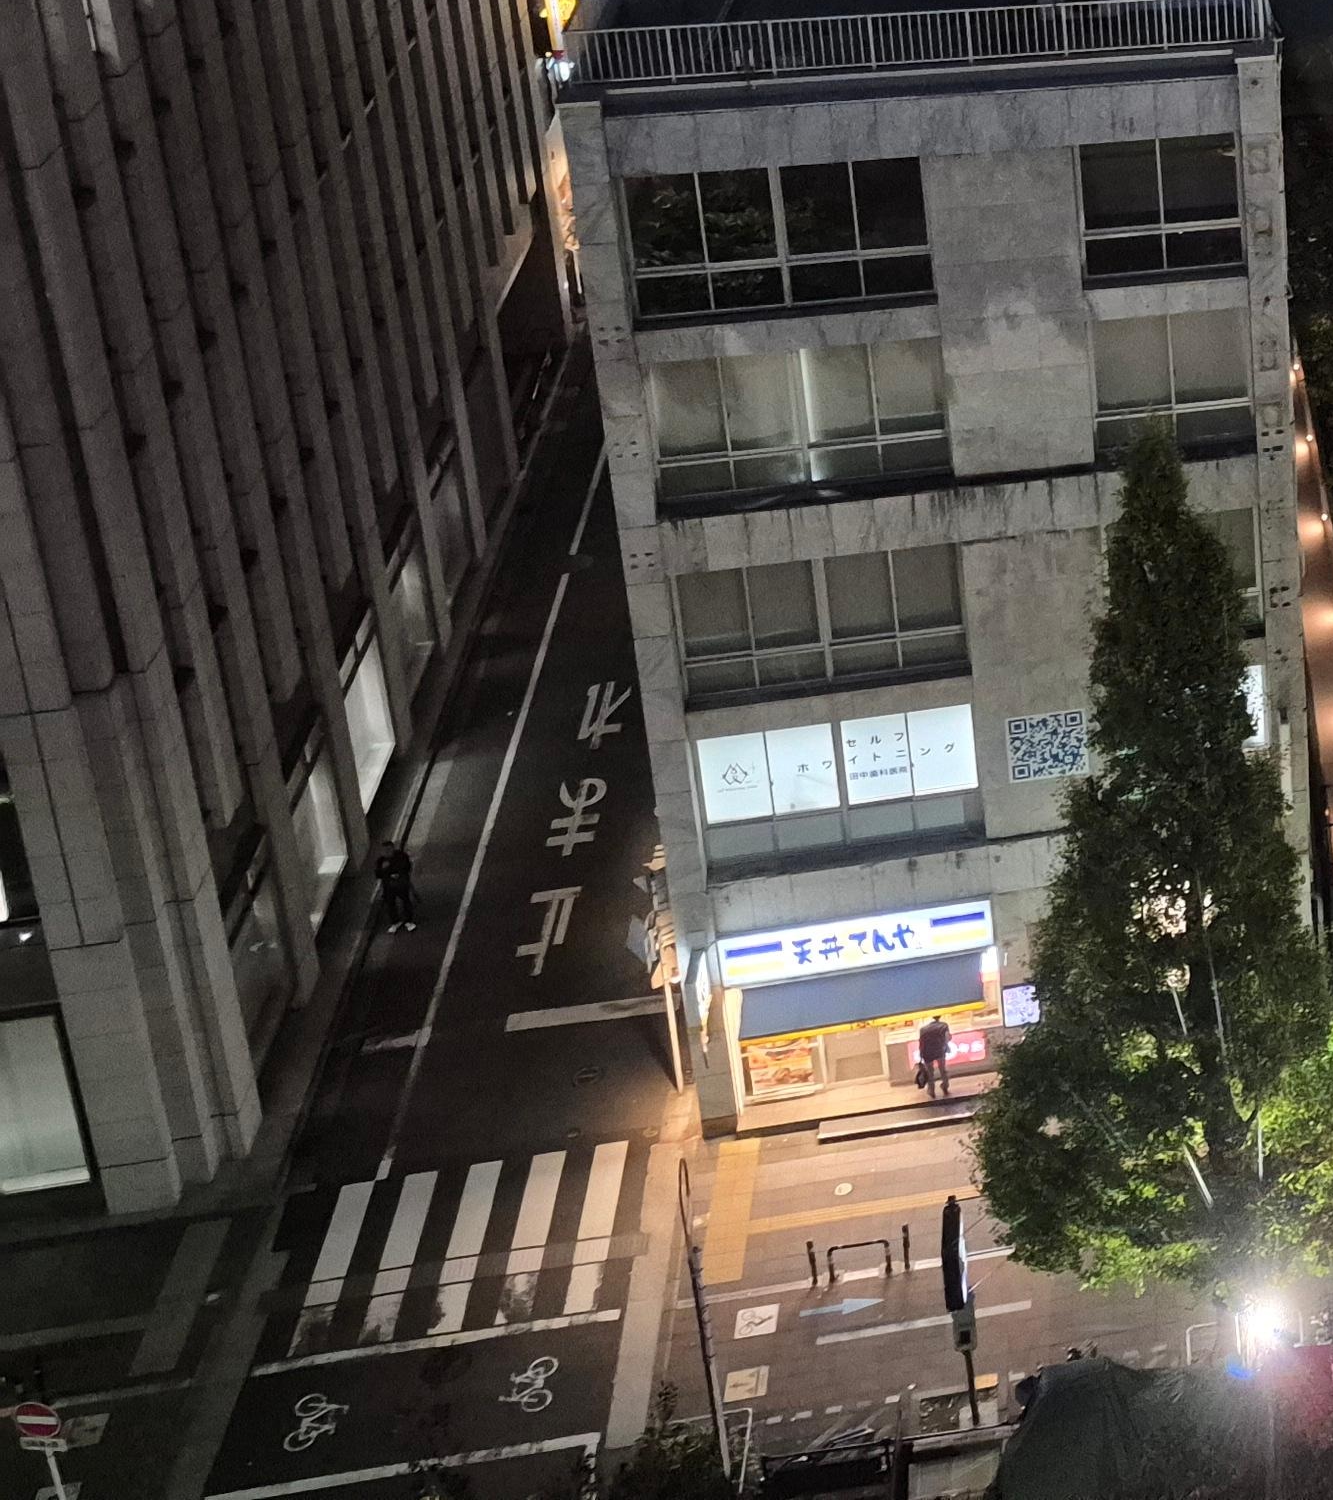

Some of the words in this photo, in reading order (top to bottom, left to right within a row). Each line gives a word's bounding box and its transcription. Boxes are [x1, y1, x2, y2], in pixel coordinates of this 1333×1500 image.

[847, 732, 904, 748] セルフ
[797, 743, 955, 773] ホワイトニング
[514, 681, 631, 976] 止まれ
